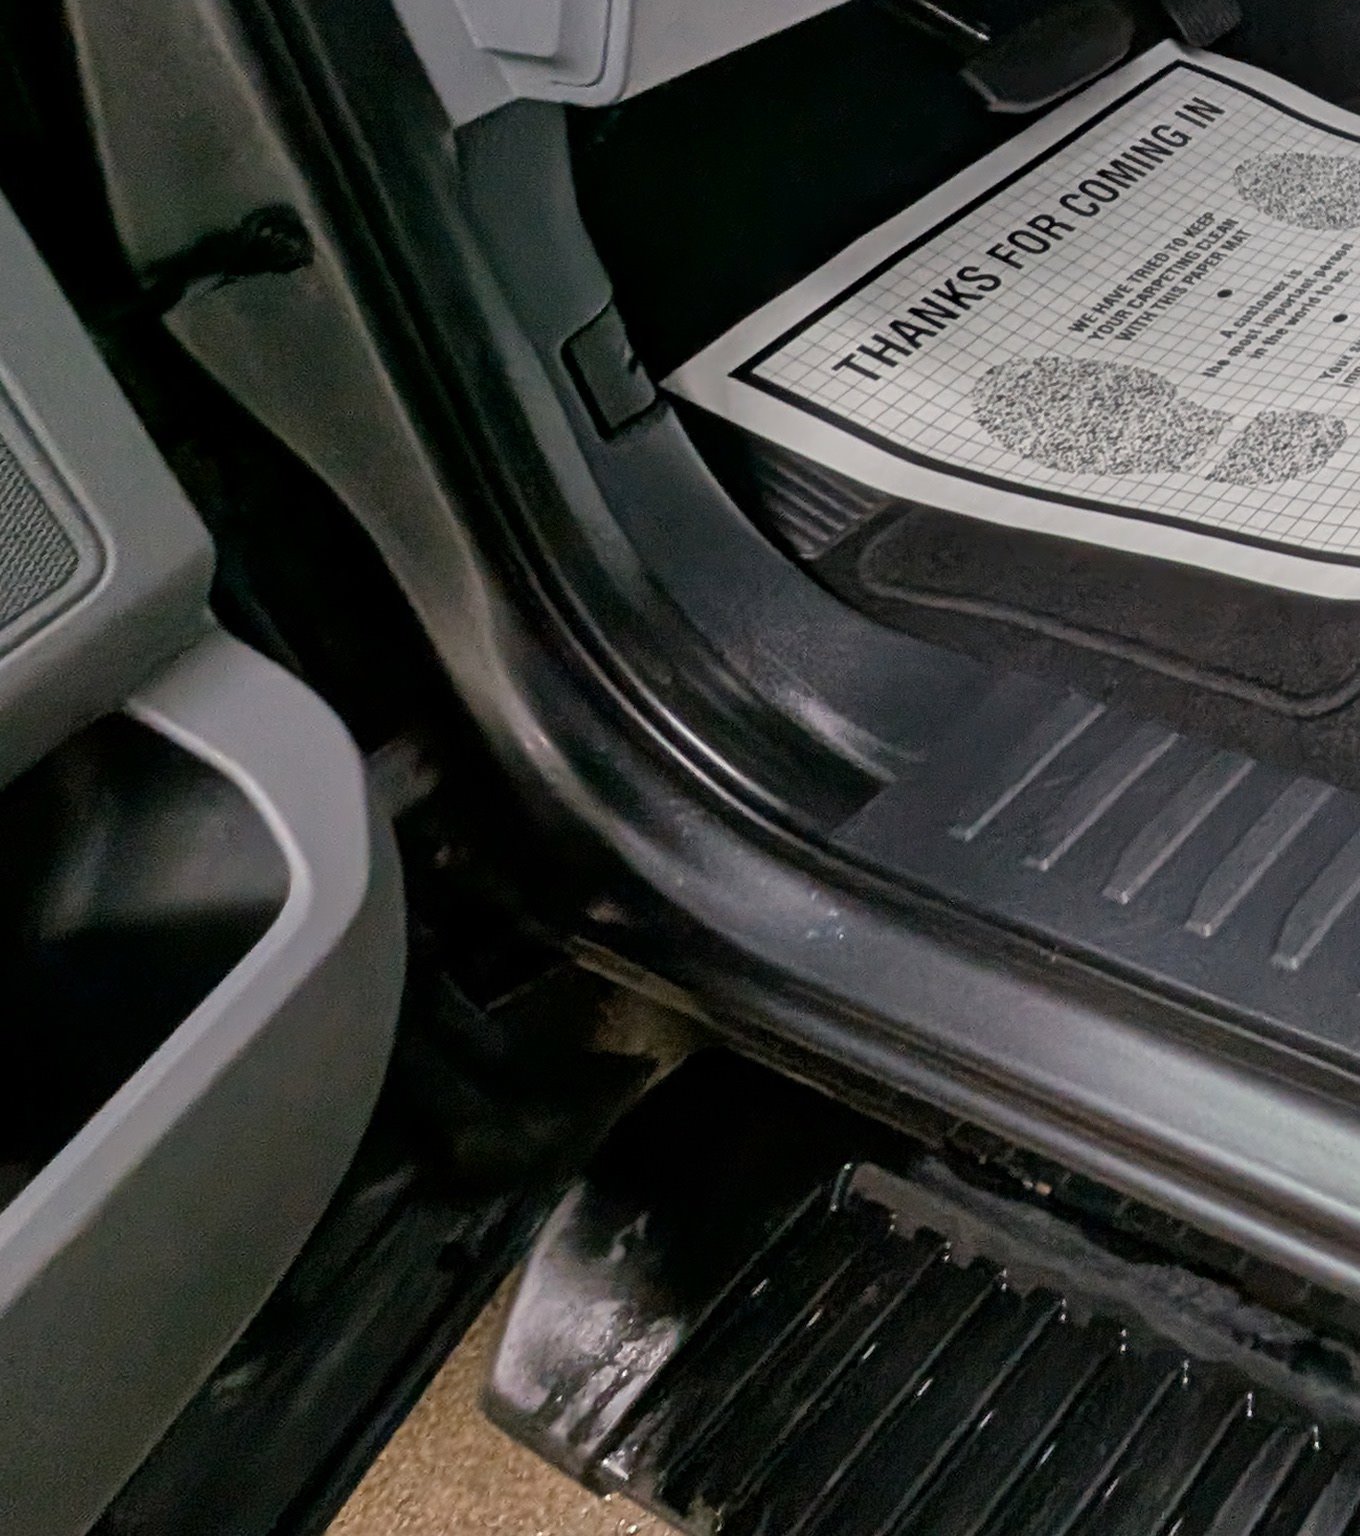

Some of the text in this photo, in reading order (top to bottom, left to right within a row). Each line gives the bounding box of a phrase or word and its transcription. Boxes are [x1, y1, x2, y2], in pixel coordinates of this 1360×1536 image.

[831, 96, 1225, 381] THANKS FOR COMING IN
[1067, 212, 1215, 332] WE HAVE TRIED TO KEEP
[1087, 218, 1239, 340] YOUR CARPETING CLEAN
[1114, 228, 1251, 341] WITH THIS PAPER MAT
[1200, 243, 1354, 378] the most important person
[1219, 269, 1303, 339] A customer is
[1246, 347, 1268, 359] in
[1261, 328, 1289, 346] the
[1284, 296, 1321, 326] world
[1314, 284, 1334, 296] to
[1318, 354, 1353, 379] Your
